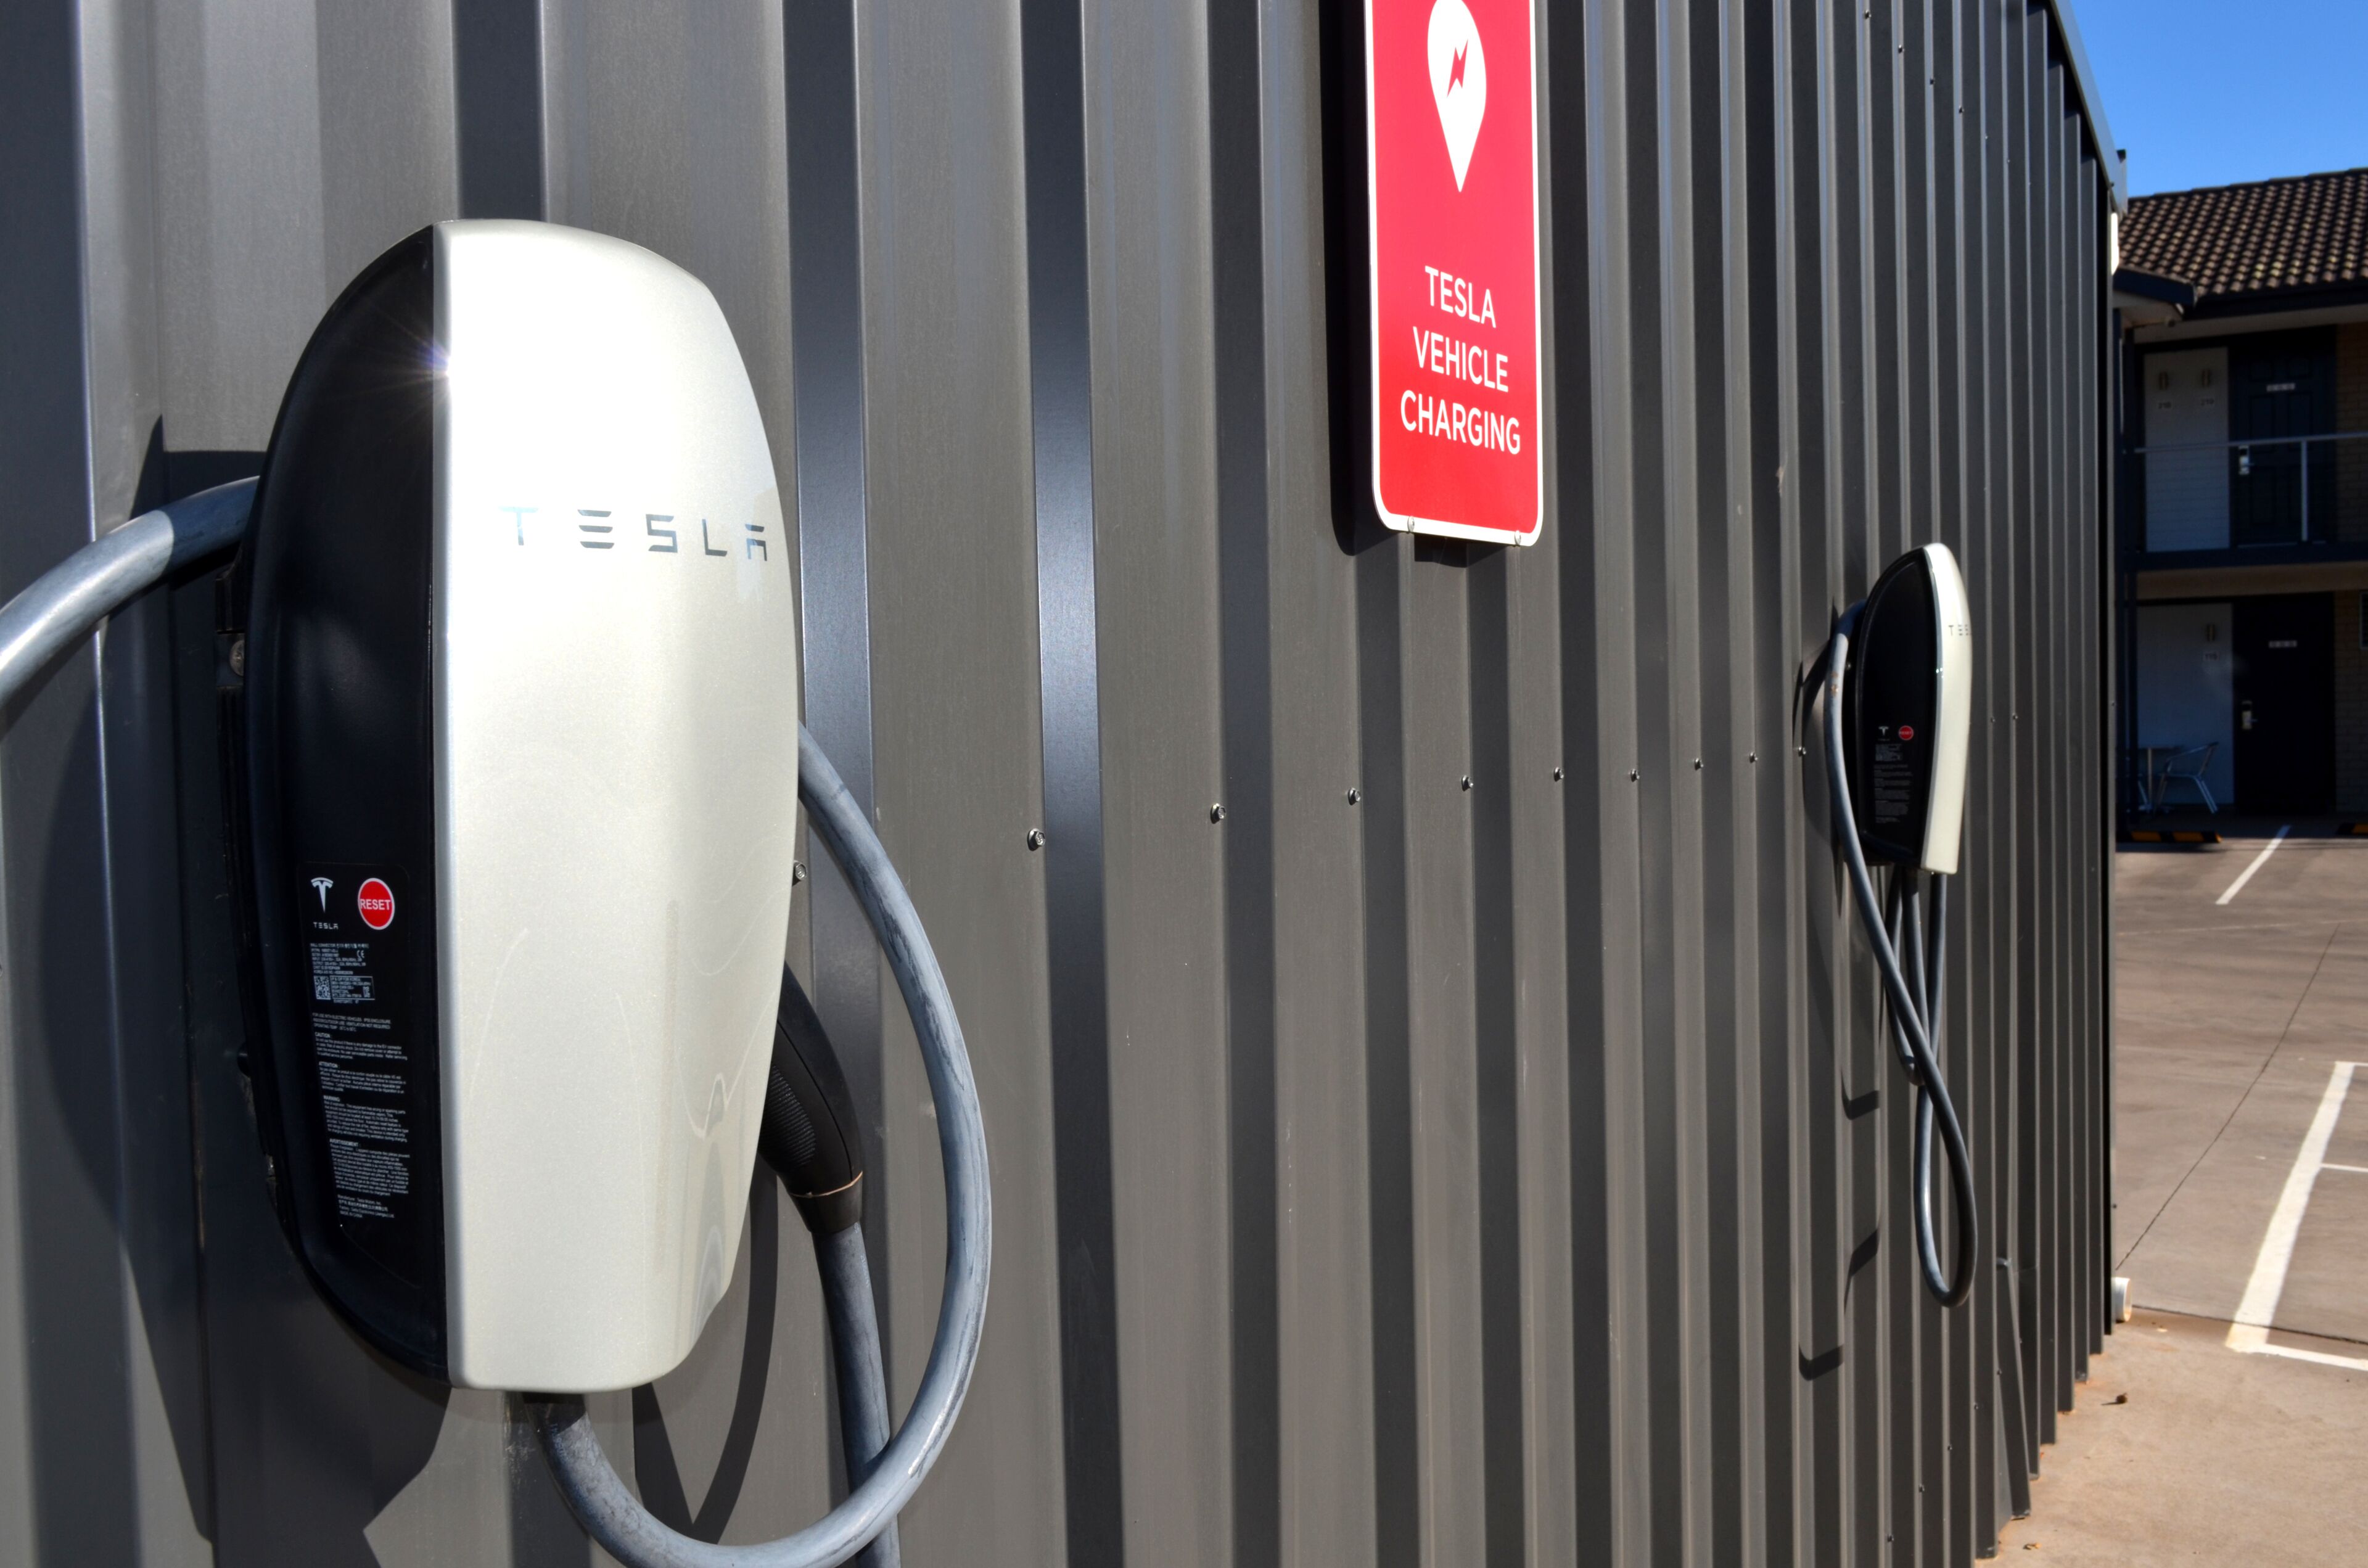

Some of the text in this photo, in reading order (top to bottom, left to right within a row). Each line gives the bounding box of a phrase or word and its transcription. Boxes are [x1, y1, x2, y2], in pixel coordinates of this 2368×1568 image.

[1424, 265, 1496, 328] TESLA
[1413, 326, 1508, 392] VEHICLE
[1400, 390, 1520, 454] CHARGING
[498, 506, 768, 561] TESLA
[313, 922, 339, 930] TESLA
[360, 898, 391, 910] RESET
